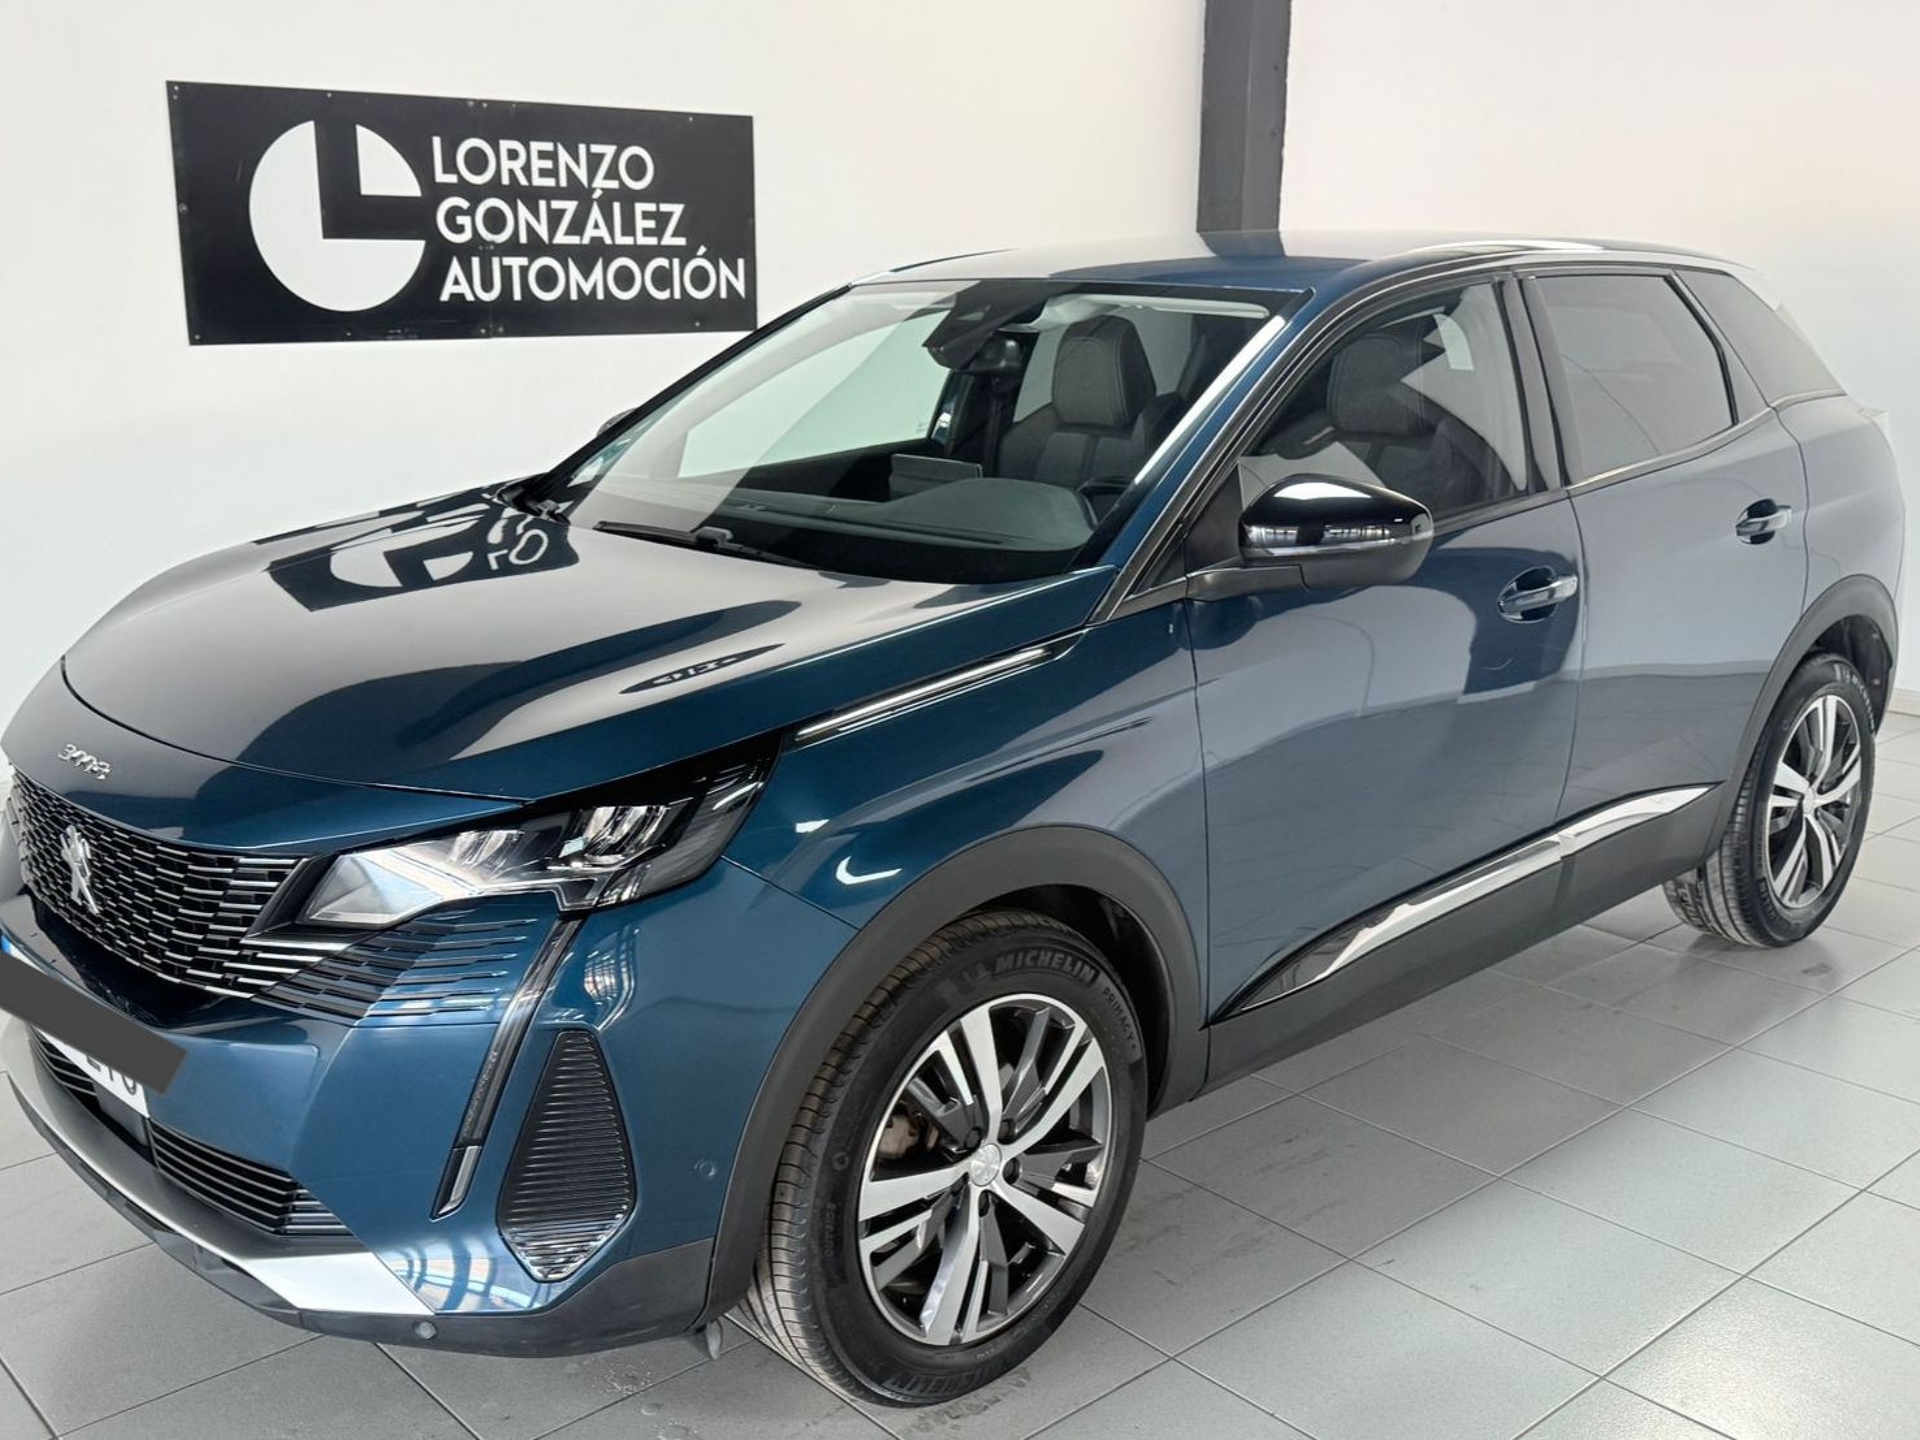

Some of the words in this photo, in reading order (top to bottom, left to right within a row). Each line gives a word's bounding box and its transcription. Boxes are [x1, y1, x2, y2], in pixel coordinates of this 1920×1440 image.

[433, 136, 655, 190] LORENZO
[437, 189, 686, 245] GONZÁLEZ
[440, 246, 746, 301] AUTOMOCIÓN
[995, 949, 1097, 984] MICHELIN
[1101, 987, 1134, 1042] PRIMACY
